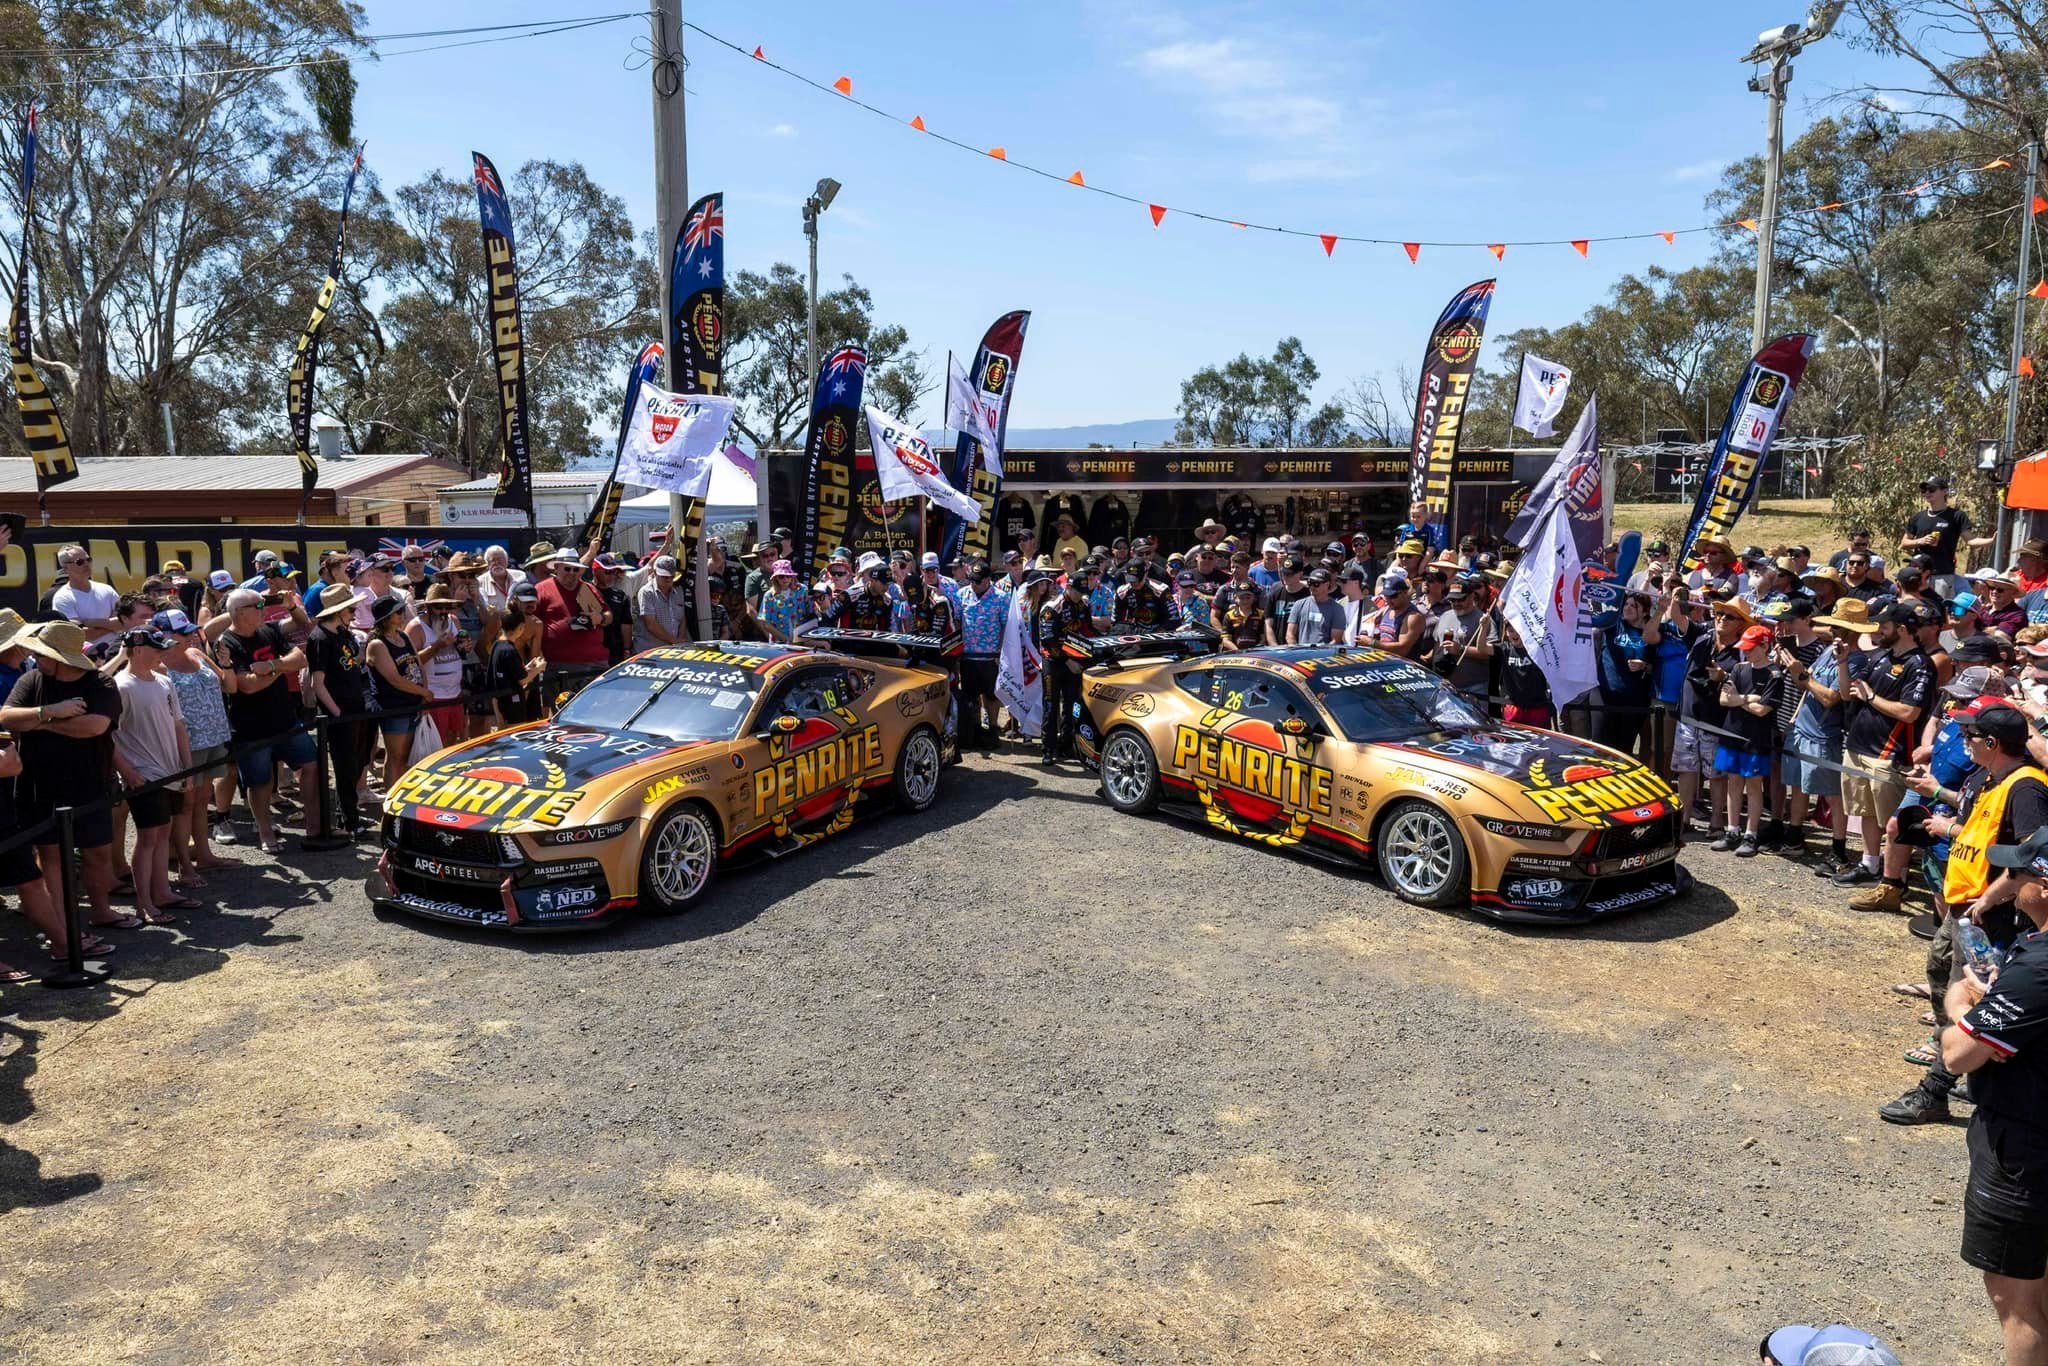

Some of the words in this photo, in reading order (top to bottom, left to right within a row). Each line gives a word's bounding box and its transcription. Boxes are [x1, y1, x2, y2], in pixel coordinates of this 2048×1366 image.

[702, 293, 715, 361] PENRITE
[1434, 335, 1482, 349] PENRITE
[654, 421, 674, 433] MOTOR
[1416, 373, 1441, 471] RACING
[831, 415, 841, 457] PENRITE
[1426, 373, 1470, 515] PENRITE
[807, 427, 823, 501] AUSTRALIAN
[1003, 461, 1036, 473] RITE
[1082, 461, 1136, 473] PENRITE
[1181, 461, 1234, 473] PENRITE
[1280, 461, 1332, 473] PENRITE
[1376, 461, 1409, 473] PENR
[1458, 461, 1510, 473] PENRITE
[480, 508, 498, 516] RURAL
[805, 507, 816, 537] MADE
[854, 540, 882, 549] Class
[898, 540, 914, 549] Oil
[863, 532, 872, 540] A
[874, 531, 906, 541] Beter
[803, 543, 812, 566] AND
[1588, 587, 1611, 597] Ford
[644, 648, 768, 669] PENRITE
[1508, 656, 1532, 667] FILA
[618, 663, 717, 684] Steadfast
[1321, 667, 1410, 689] Steadfast
[650, 680, 665, 690] 19
[680, 683, 717, 696] Payne
[823, 690, 837, 709] 19
[1224, 691, 1243, 711] 26
[523, 741, 589, 757] HIRE
[691, 773, 711, 785] AUTO
[753, 722, 883, 818] PENRITE
[1172, 724, 1334, 817] PENRITE
[1385, 766, 1426, 787] JAX
[643, 775, 685, 804] JAX
[680, 766, 708, 779] TYRES
[1432, 785, 1463, 801] AUTO
[401, 768, 586, 826] PENRITE
[556, 828, 606, 843] GROVE
[606, 823, 624, 834] HIRE
[1486, 820, 1533, 838] GROVE
[1533, 828, 1553, 837] HIRE
[1952, 842, 1981, 863] RITY
[414, 856, 445, 878] APEX
[444, 865, 480, 880] STEEL
[534, 865, 565, 875] DASHER
[570, 861, 599, 870] FISHER
[1510, 856, 1538, 864] DASHER
[1543, 859, 1571, 868] FISHER
[1620, 854, 1646, 870] APEX
[1525, 880, 1562, 896] NED
[399, 893, 481, 918] Steadfast
[557, 889, 597, 906] NED
[1585, 887, 1657, 912] Steadfast
